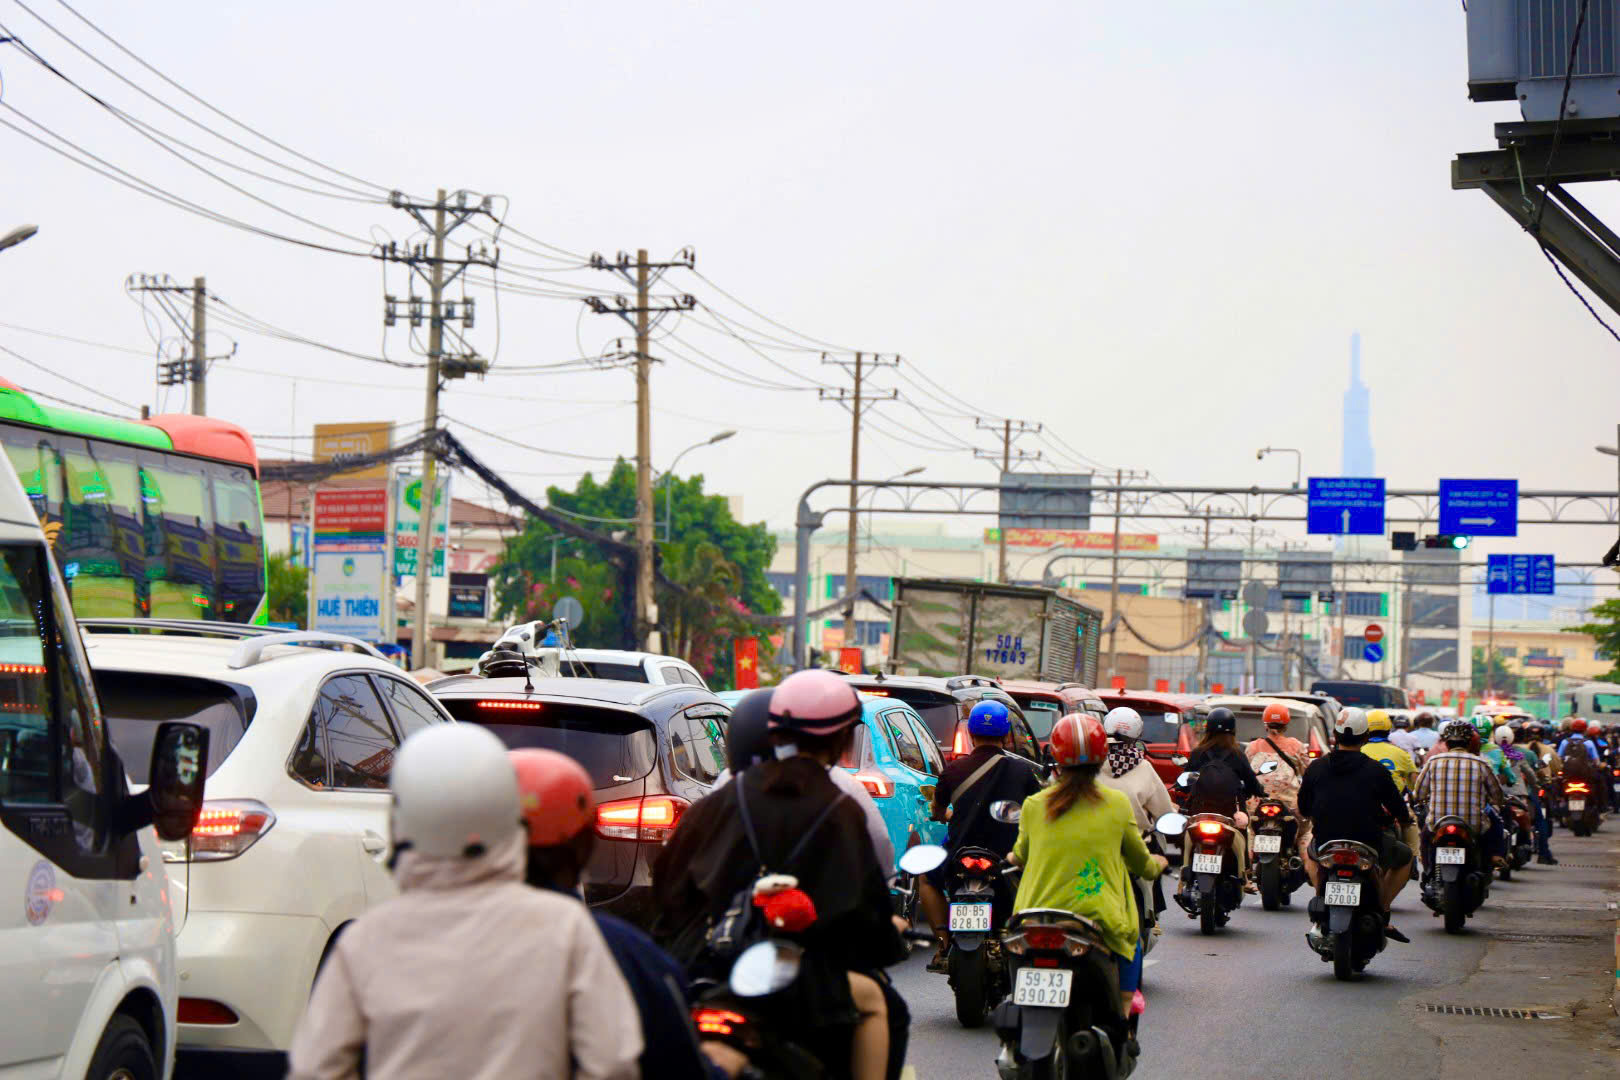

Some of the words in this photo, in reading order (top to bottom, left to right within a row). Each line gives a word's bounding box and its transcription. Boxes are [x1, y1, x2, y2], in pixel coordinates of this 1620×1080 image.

[986, 648, 1025, 664] 17643
[956, 905, 985, 917] 60-B5
[951, 918, 988, 929] 828.18
[1025, 971, 1064, 987] 59-X3
[1018, 987, 1067, 1004] 390.20
